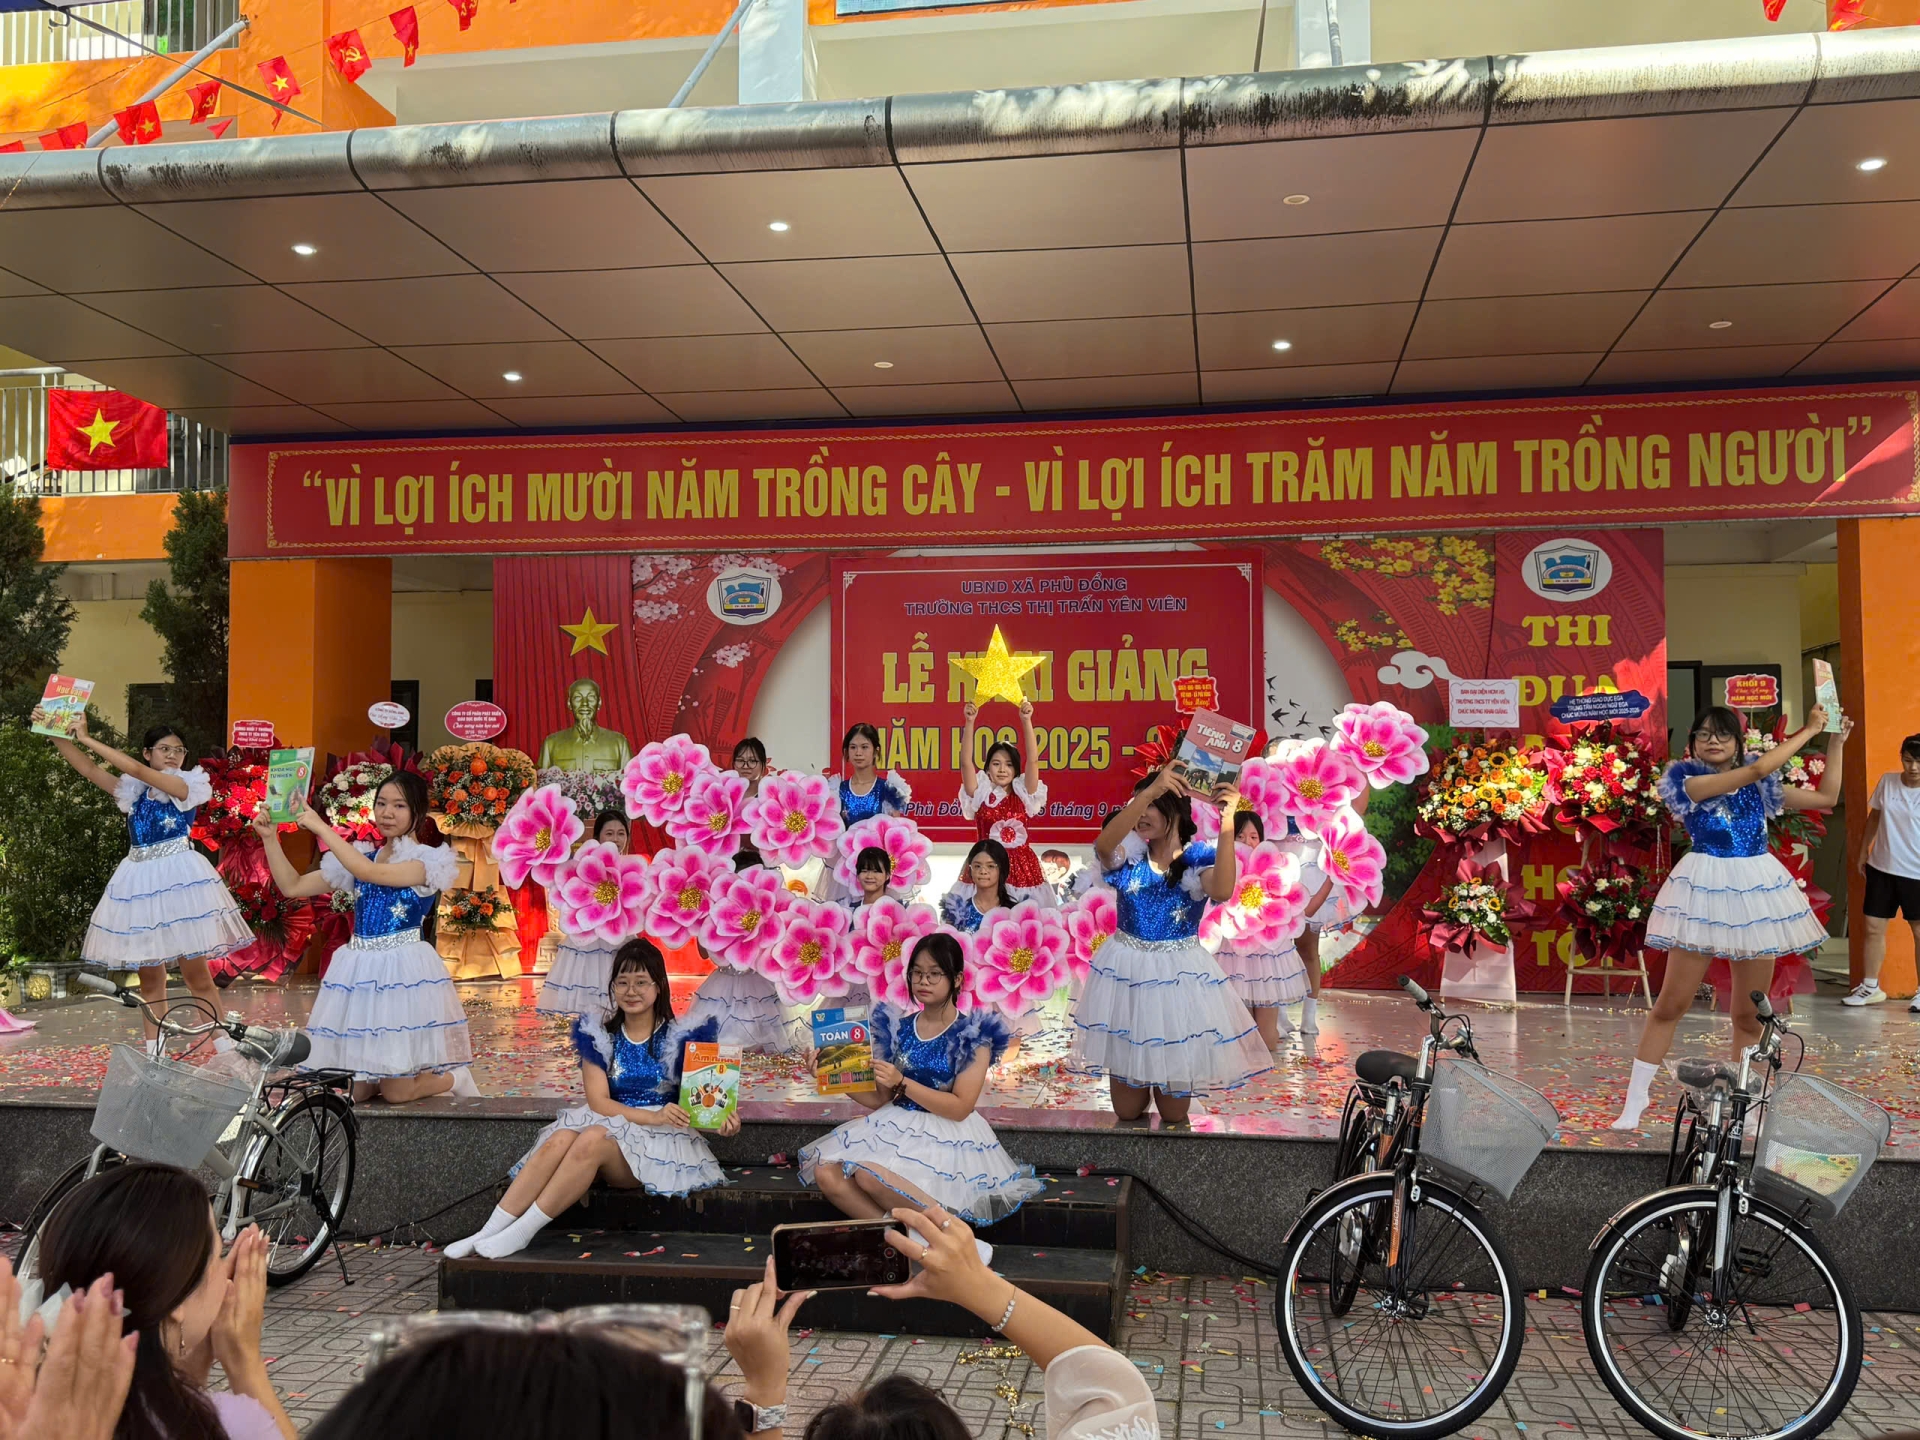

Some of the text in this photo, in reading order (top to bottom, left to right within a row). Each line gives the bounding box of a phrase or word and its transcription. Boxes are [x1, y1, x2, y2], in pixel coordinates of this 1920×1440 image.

[374, 475, 434, 535] LỢI
[449, 461, 513, 523] ÍCH
[527, 458, 633, 521] MƯỜI
[647, 457, 740, 519] NĂM
[753, 446, 887, 518] TRỒNG
[903, 451, 982, 515] CÂY
[995, 486, 1010, 497] -
[1025, 446, 1063, 512] VÌ
[1079, 457, 1144, 521] LỢI
[1161, 441, 1231, 507] ÍCH
[1247, 437, 1374, 504] TRĂM
[1389, 430, 1498, 499] NĂM
[1513, 414, 1670, 494] TRỒNG
[1688, 413, 1872, 489] NGƯỜI”
[961, 572, 1127, 595] UBND XÃ PHÙ ĐỔNG
[904, 594, 1187, 616] TRƯỜNG THCS THỊ TRẤN YÊN VIÊN
[1522, 614, 1612, 646] THI
[883, 631, 935, 703] LỄ
[947, 650, 1053, 703] KI
[1736, 678, 1758, 687] KHỐI
[1034, 726, 1110, 770] 2025
[1205, 737, 1244, 753] ANH 8
[904, 799, 933, 817] Phù
[1050, 801, 1093, 820] tháng
[1098, 801, 1107, 816] 9
[820, 1027, 861, 1041] TOÁN 8
